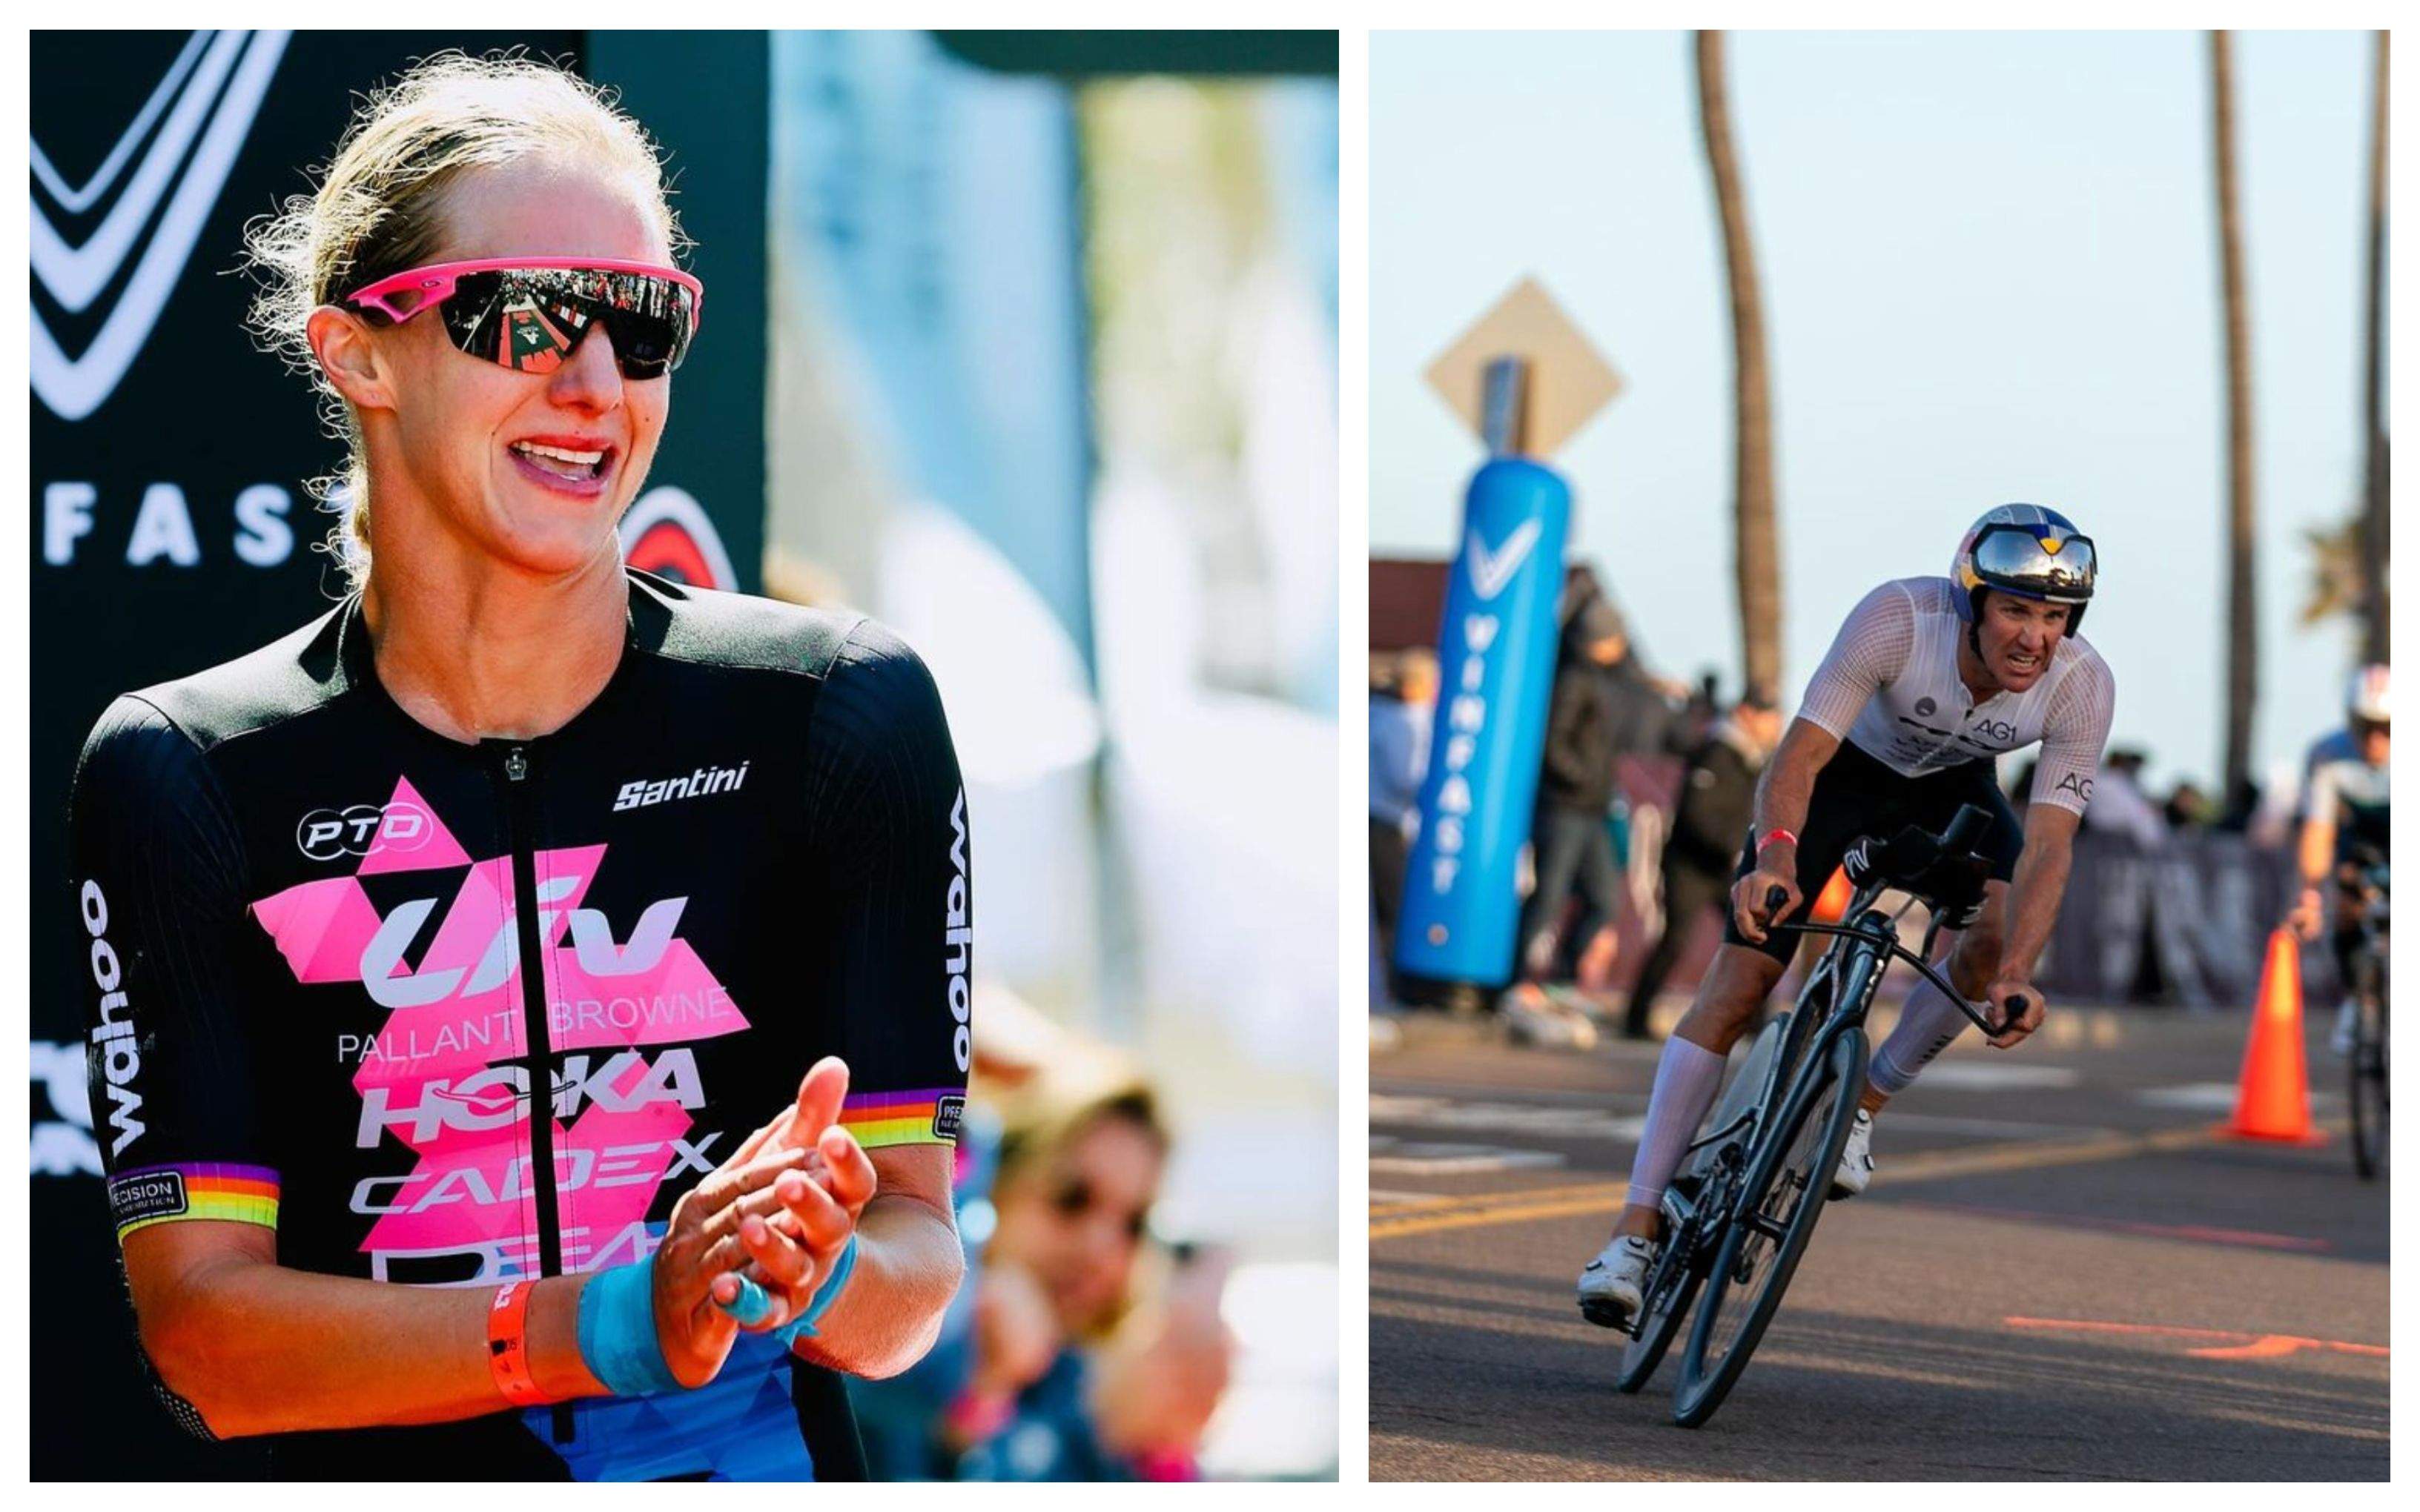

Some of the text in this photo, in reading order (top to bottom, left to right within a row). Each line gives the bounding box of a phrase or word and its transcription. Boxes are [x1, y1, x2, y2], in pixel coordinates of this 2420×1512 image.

[43, 482, 354, 569] FAS
[1973, 718, 2017, 742] AG1
[612, 760, 750, 812] Santini
[305, 815, 423, 849] PTO
[945, 784, 972, 1072] wahoo
[81, 878, 147, 1158] wahoo
[337, 985, 731, 1064] PALLANT BROWNE
[356, 1047, 707, 1148] HOKA
[111, 1181, 173, 1207] ECISION
[348, 1131, 724, 1215] CADEX
